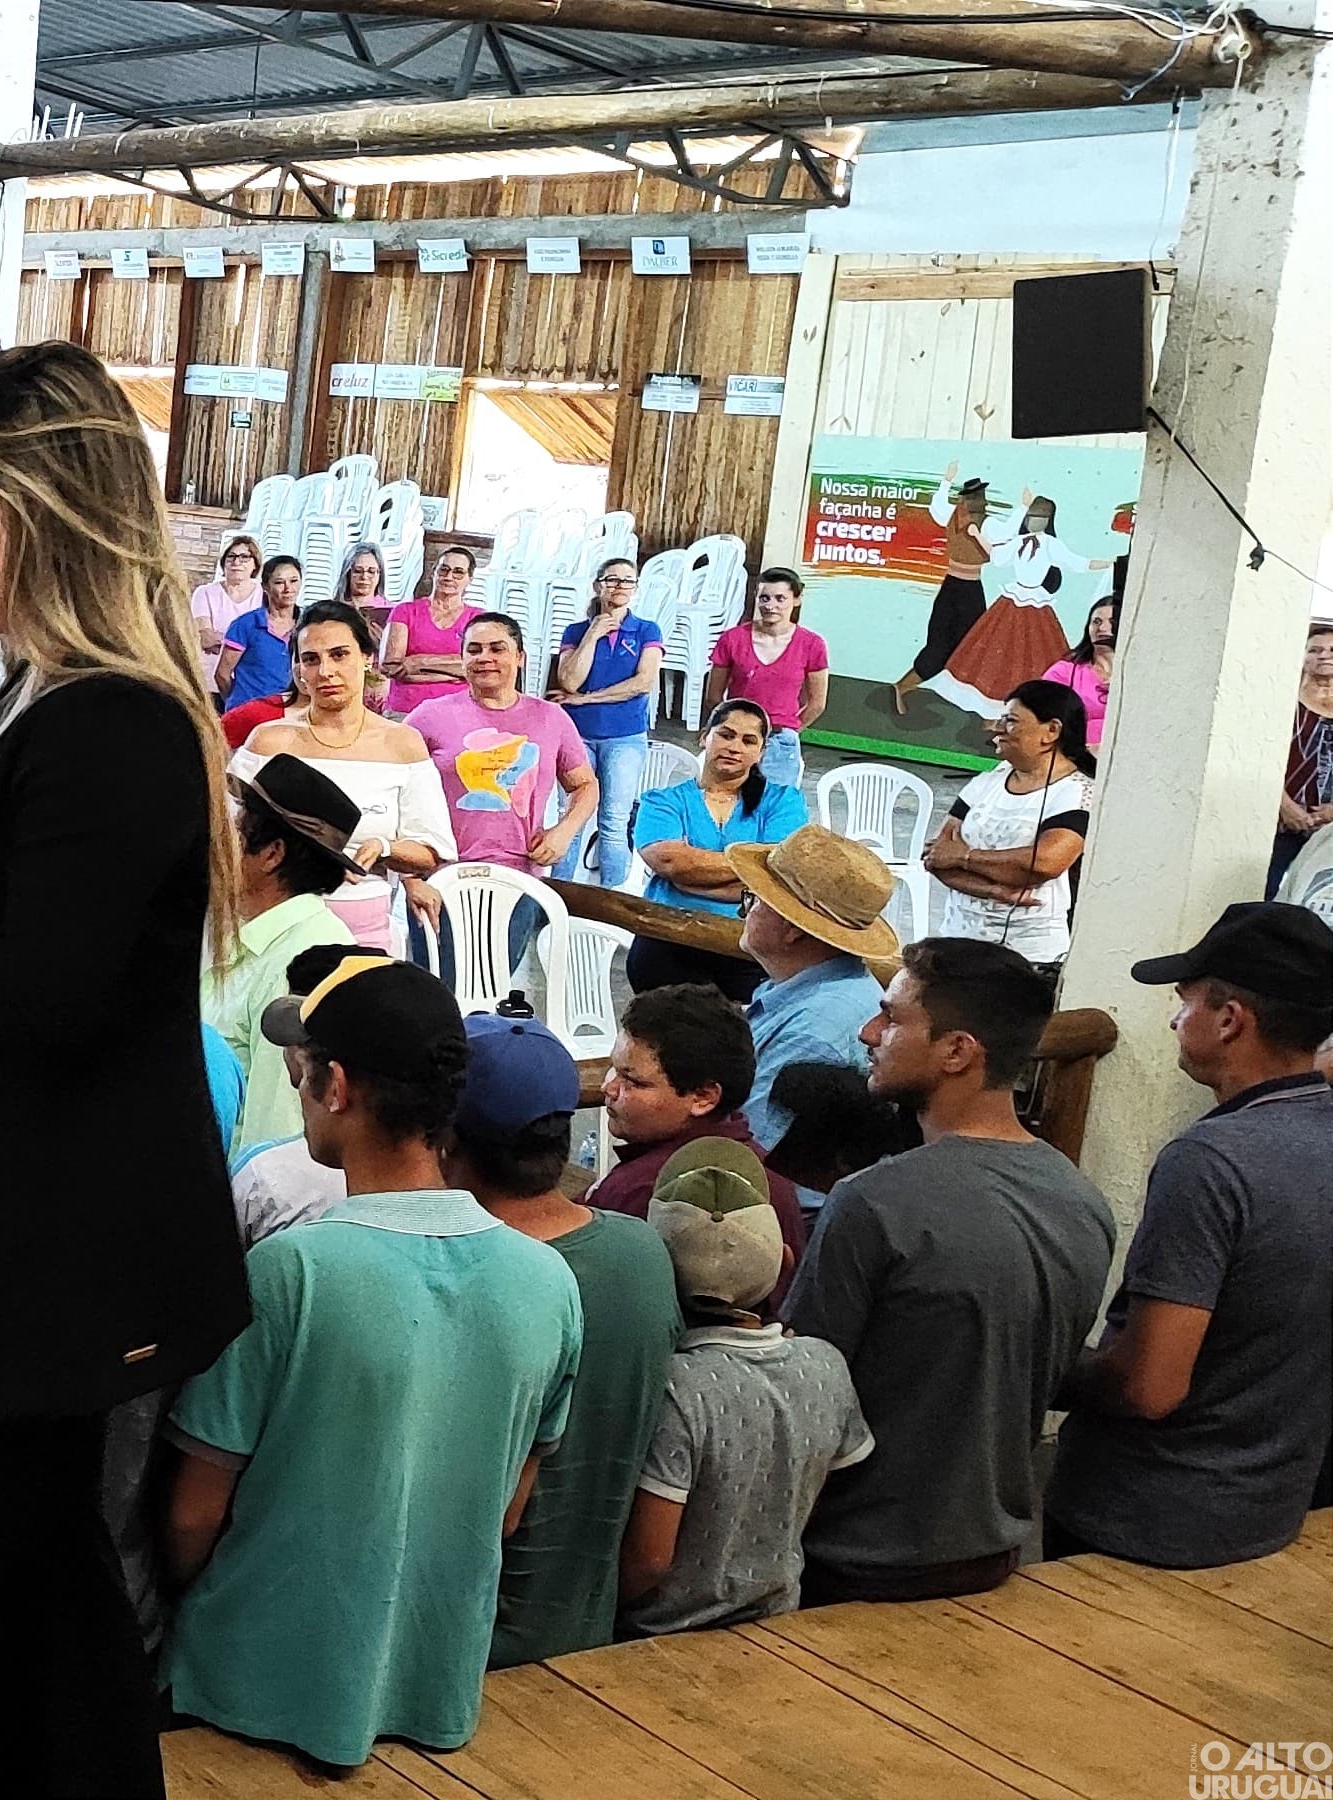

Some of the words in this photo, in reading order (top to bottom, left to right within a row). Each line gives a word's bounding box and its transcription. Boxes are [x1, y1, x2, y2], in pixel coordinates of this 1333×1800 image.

[332, 373, 369, 388] creluz
[819, 476, 869, 497] Nossa
[871, 481, 919, 501] maior
[818, 497, 882, 520] façanha
[885, 503, 898, 520] é
[815, 520, 898, 542] crescer
[812, 537, 887, 565] juntos.
